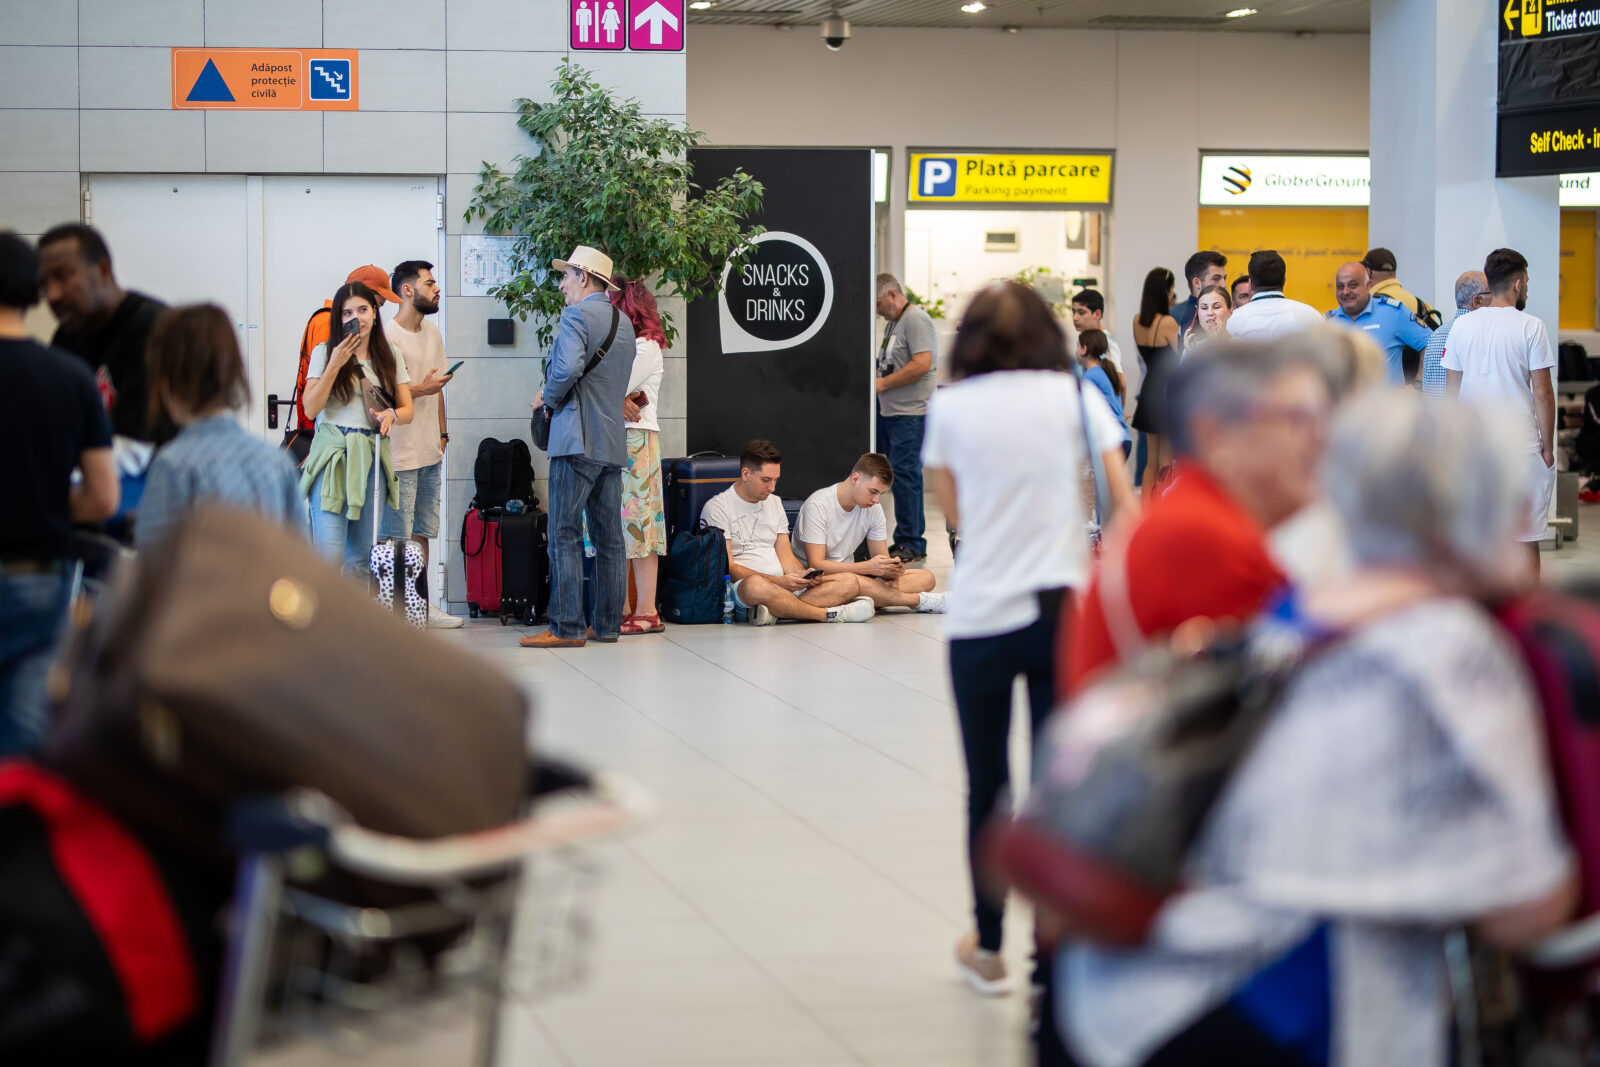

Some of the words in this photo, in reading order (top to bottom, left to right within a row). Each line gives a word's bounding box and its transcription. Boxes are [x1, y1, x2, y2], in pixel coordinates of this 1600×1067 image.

[1545, 9, 1577, 32] Ticket
[1579, 8, 1600, 27] cou
[251, 63, 292, 74] Adăpost
[251, 88, 277, 98] civilă
[1530, 131, 1551, 154] Self
[1552, 128, 1584, 152] Check
[966, 159, 1017, 177] Plată
[1024, 163, 1101, 181] parcare
[1264, 172, 1370, 188] GlobeGroun
[965, 184, 1010, 197] Parking
[1014, 186, 1068, 197] payment
[742, 263, 809, 286] SNACKS
[772, 287, 781, 297] &
[746, 299, 805, 321] DRINKS
